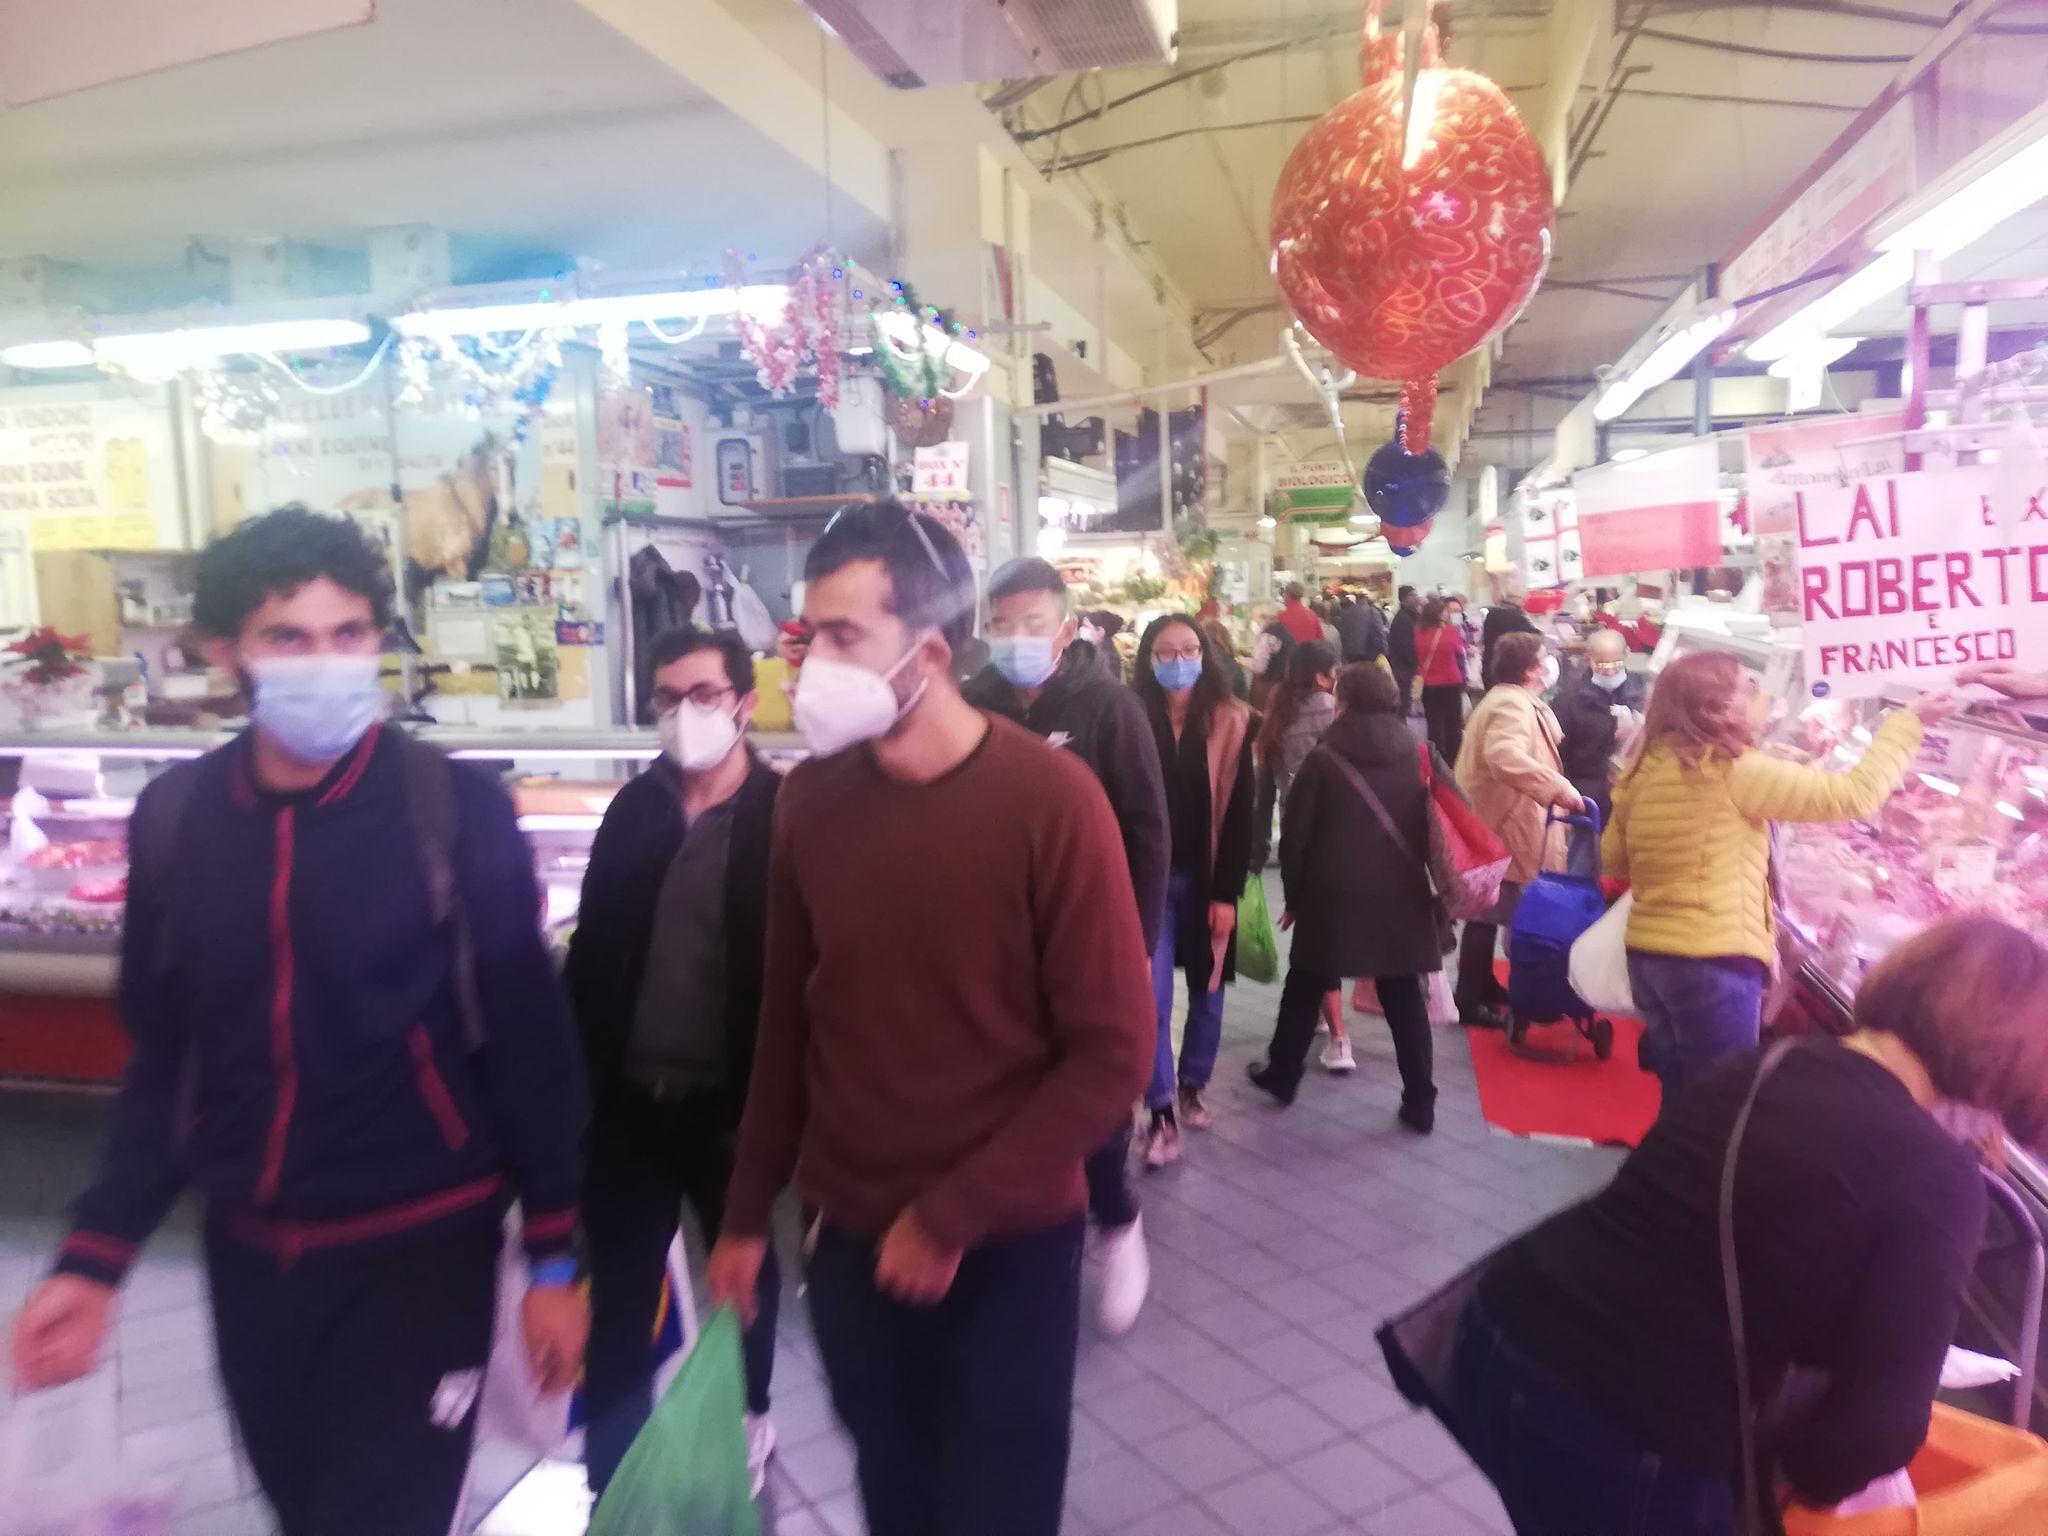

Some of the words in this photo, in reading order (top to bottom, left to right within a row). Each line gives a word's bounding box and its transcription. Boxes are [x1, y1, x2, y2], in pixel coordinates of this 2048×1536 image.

[1277, 474, 1353, 488] BIOLOGICO
[1795, 479, 1899, 548] LAI
[1801, 545, 2048, 622] ROBERTO
[1928, 613, 1940, 629] E
[1819, 628, 2015, 676] FRANCESCO
